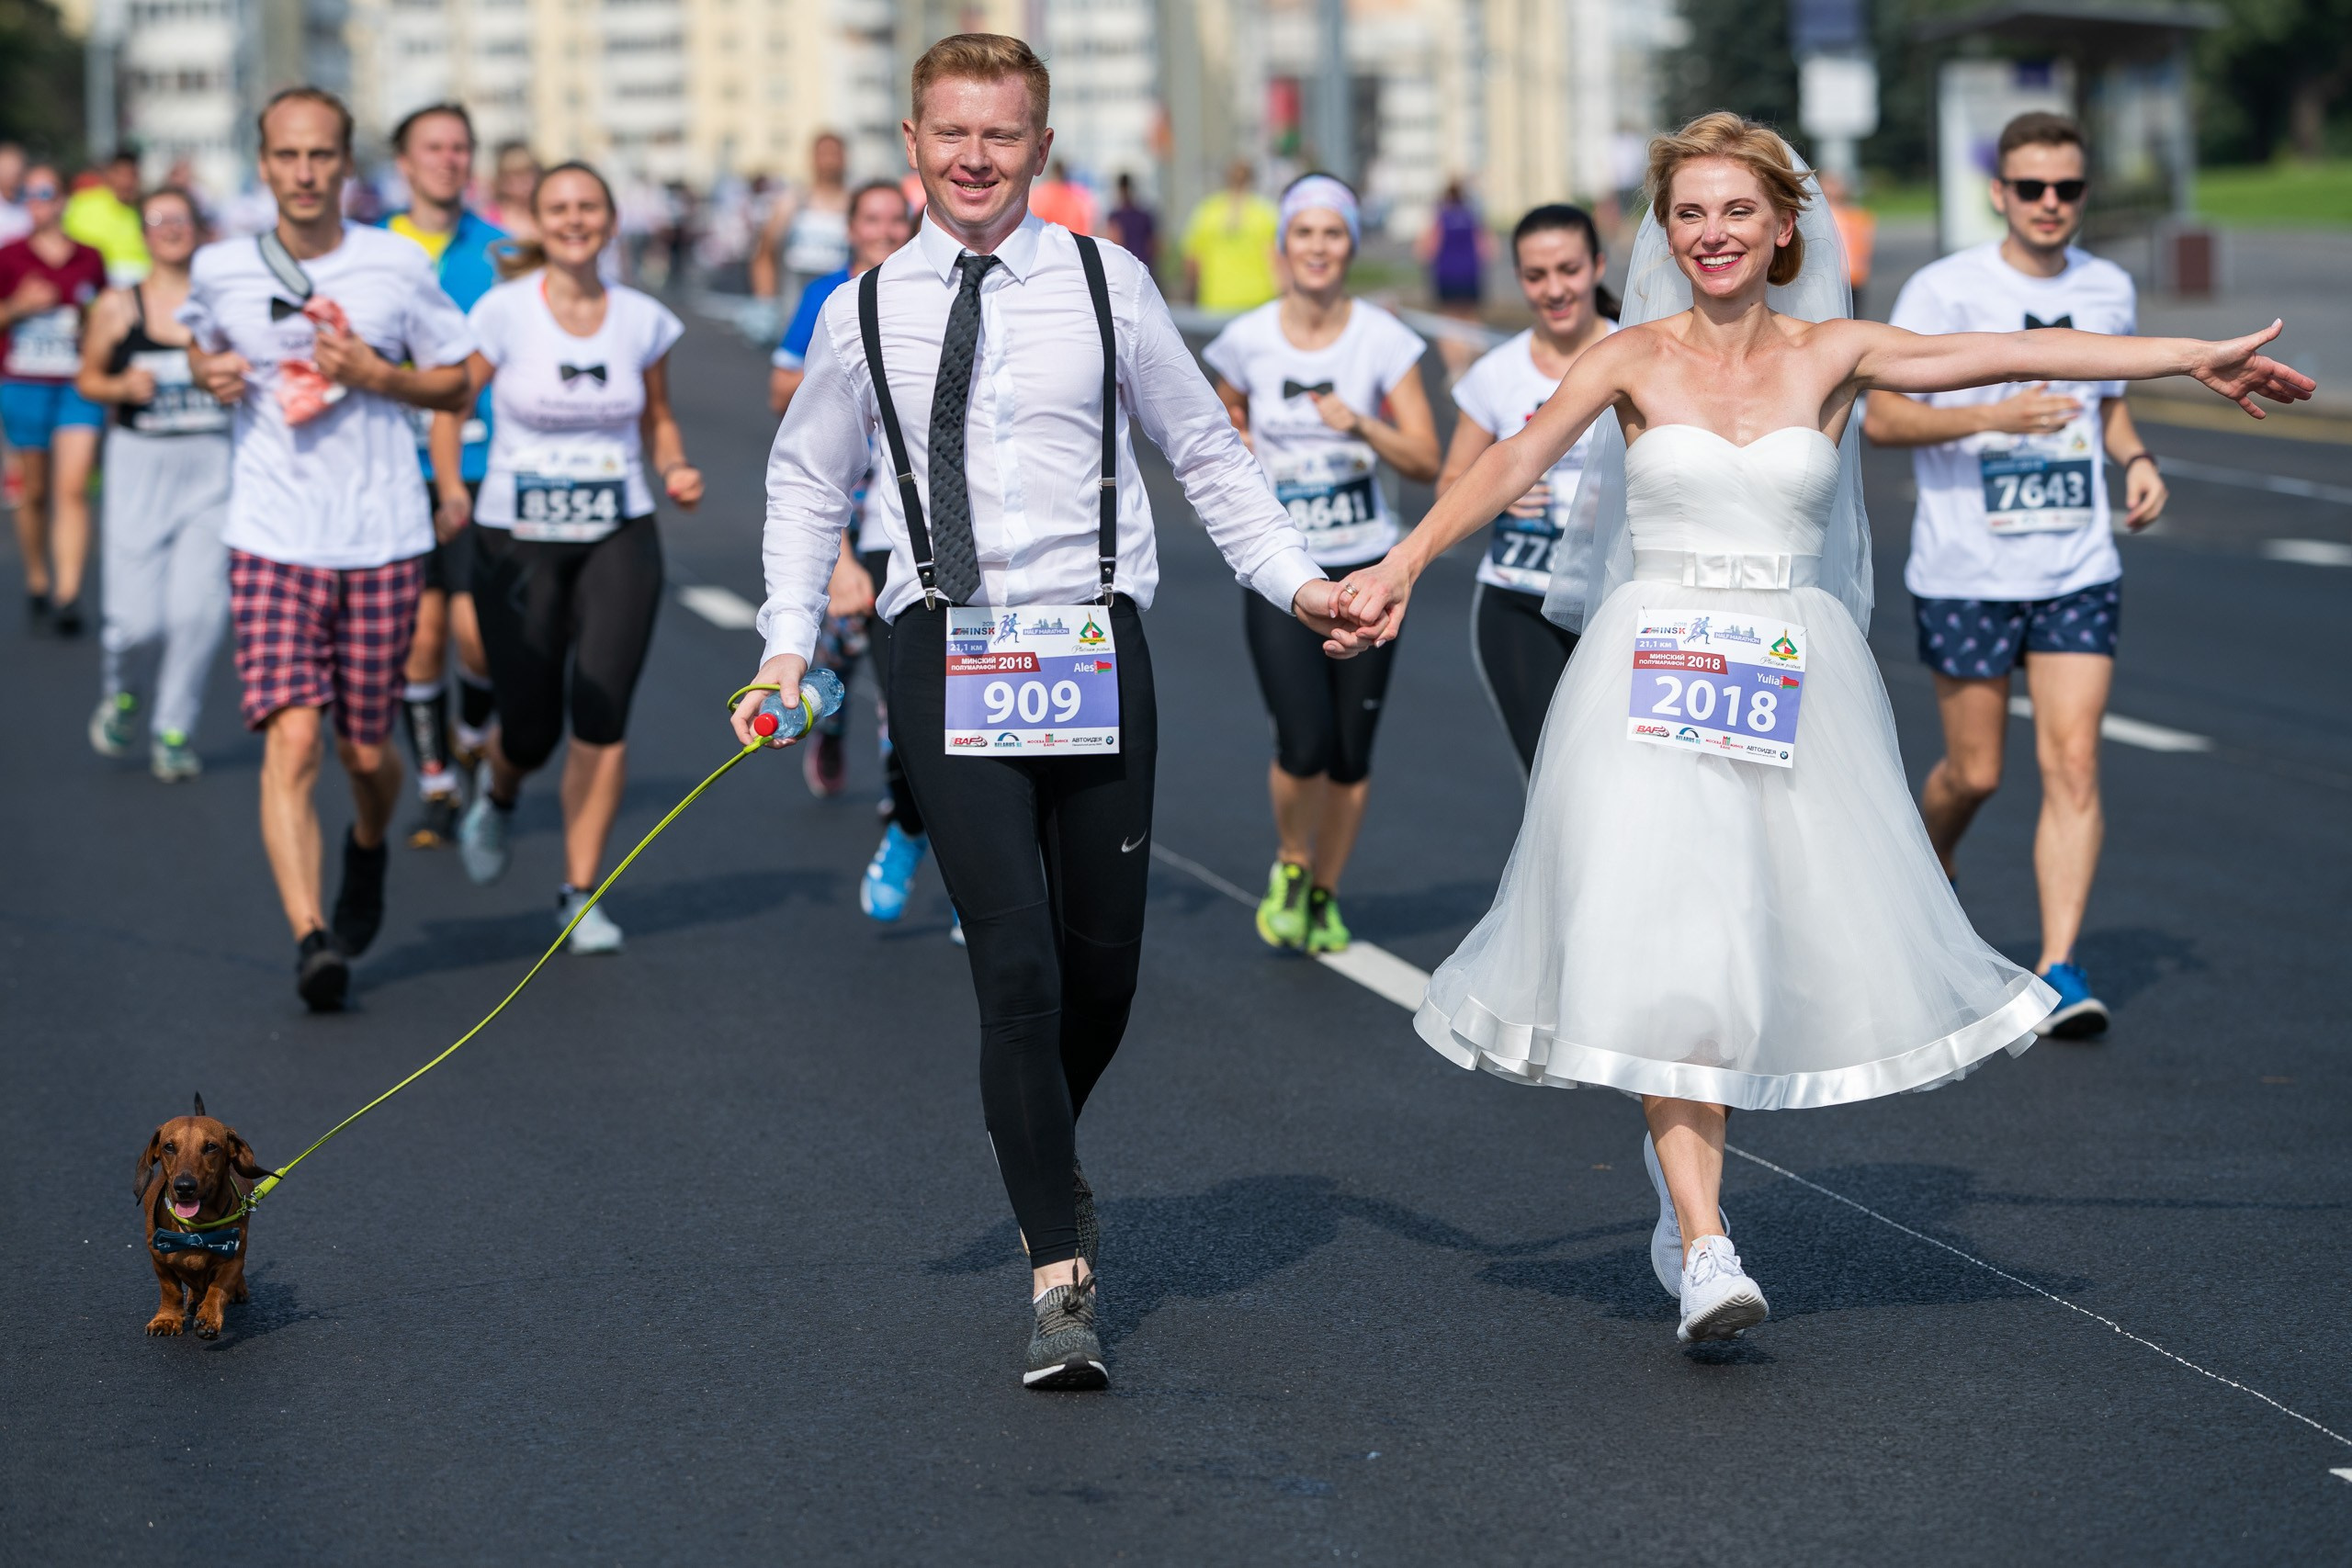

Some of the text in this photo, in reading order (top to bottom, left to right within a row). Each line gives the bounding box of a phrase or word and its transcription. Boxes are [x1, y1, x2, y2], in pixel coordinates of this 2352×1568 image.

[1994, 470, 2086, 511] 7643
[522, 487, 618, 523] 8554
[1286, 489, 1368, 530] 8641
[1730, 635, 1760, 643] MARATHON
[950, 643, 968, 652] 21,1
[961, 656, 996, 664] МИНСКИЙ
[998, 656, 1033, 669] 2018
[1687, 656, 1721, 671] 2018
[1073, 662, 1095, 672] Ales
[1757, 672, 1780, 685] Yulia
[983, 680, 1081, 724] 909
[1651, 675, 1779, 733] 2018
[1747, 745, 1777, 755] АВТОИДЕЯ
